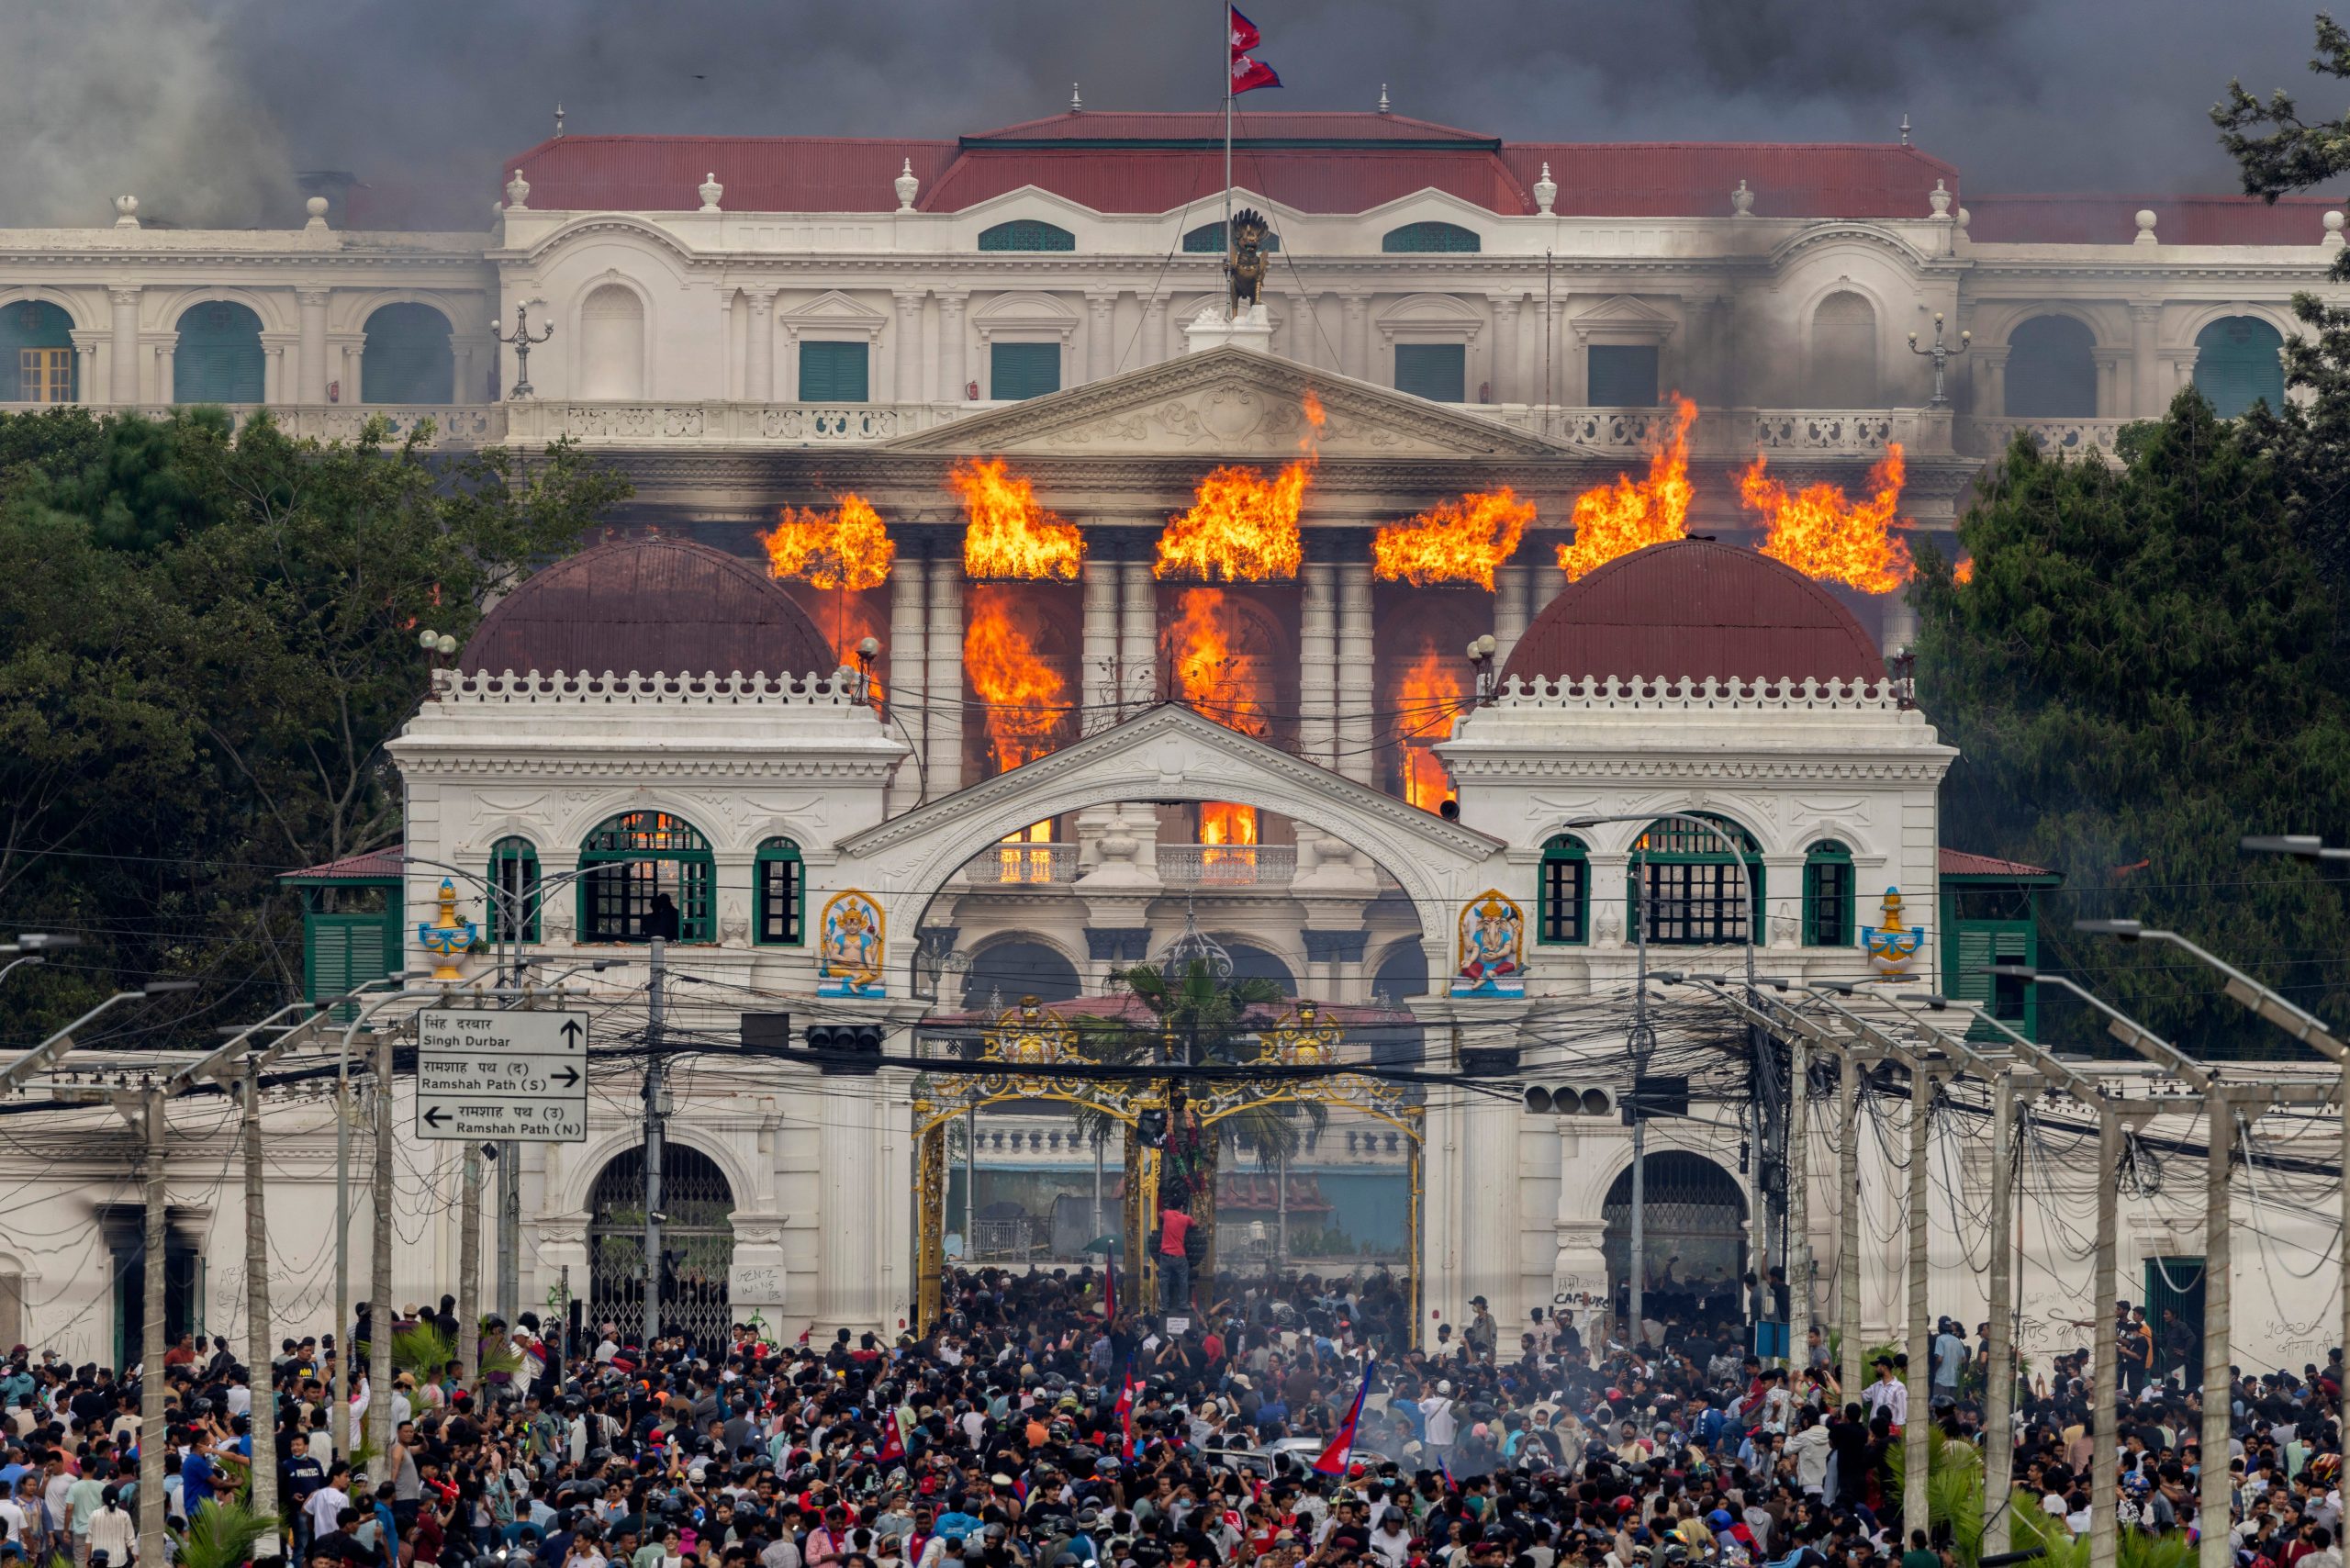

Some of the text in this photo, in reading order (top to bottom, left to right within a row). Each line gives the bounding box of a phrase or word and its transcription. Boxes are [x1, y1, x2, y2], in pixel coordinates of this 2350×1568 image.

[425, 1014, 492, 1030] सिंह दरबार
[424, 1036, 510, 1047] Singh Durbar
[423, 1061, 529, 1076] रामशाह पथ (द)
[422, 1079, 547, 1092] Ramshah Path (S)
[458, 1106, 565, 1121] रामशाह पथ (उ)
[456, 1123, 580, 1137] Ramshah Path (N)
